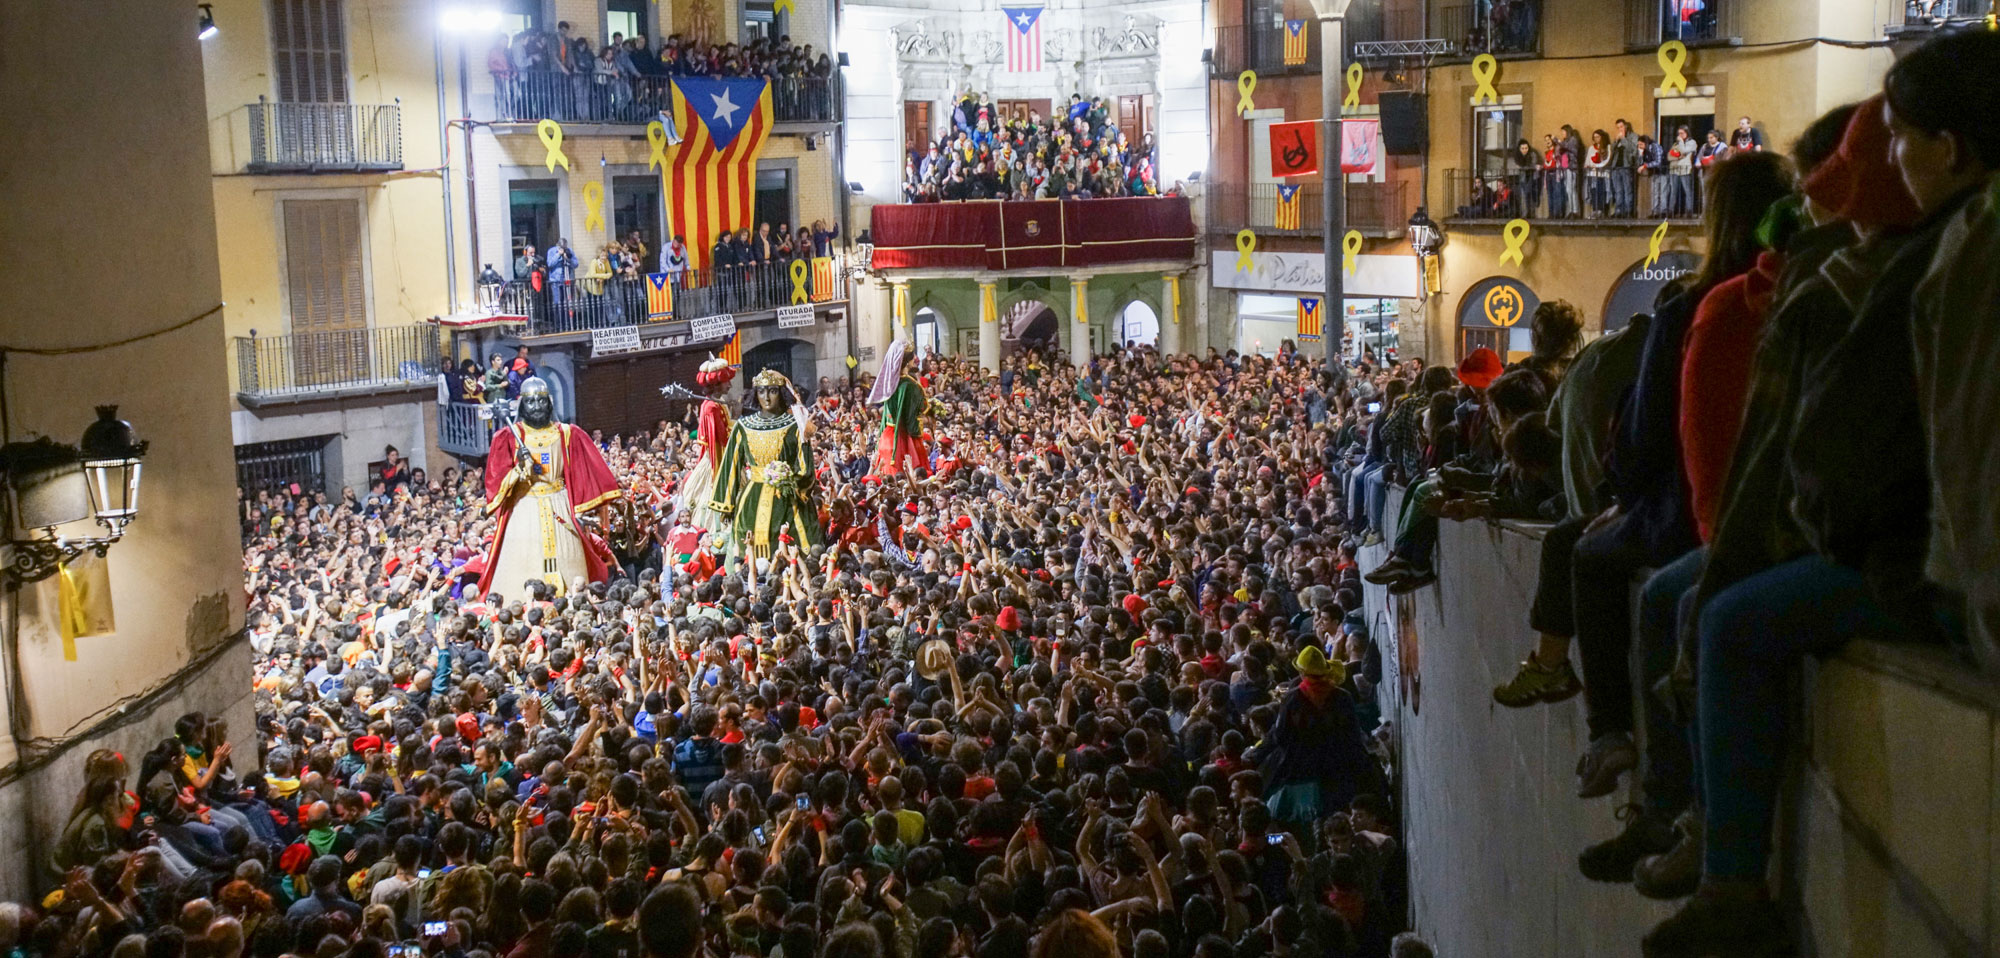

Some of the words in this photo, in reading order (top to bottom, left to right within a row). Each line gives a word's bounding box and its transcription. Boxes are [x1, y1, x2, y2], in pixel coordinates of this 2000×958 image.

[1644, 265, 1695, 280] boti
[779, 306, 813, 316] ATURADA
[692, 315, 732, 327] COMPLETEM
[711, 321, 732, 330] CATALANA
[593, 327, 637, 339] REAFIRMEM
[599, 336, 626, 345] D'OCTUBRE
